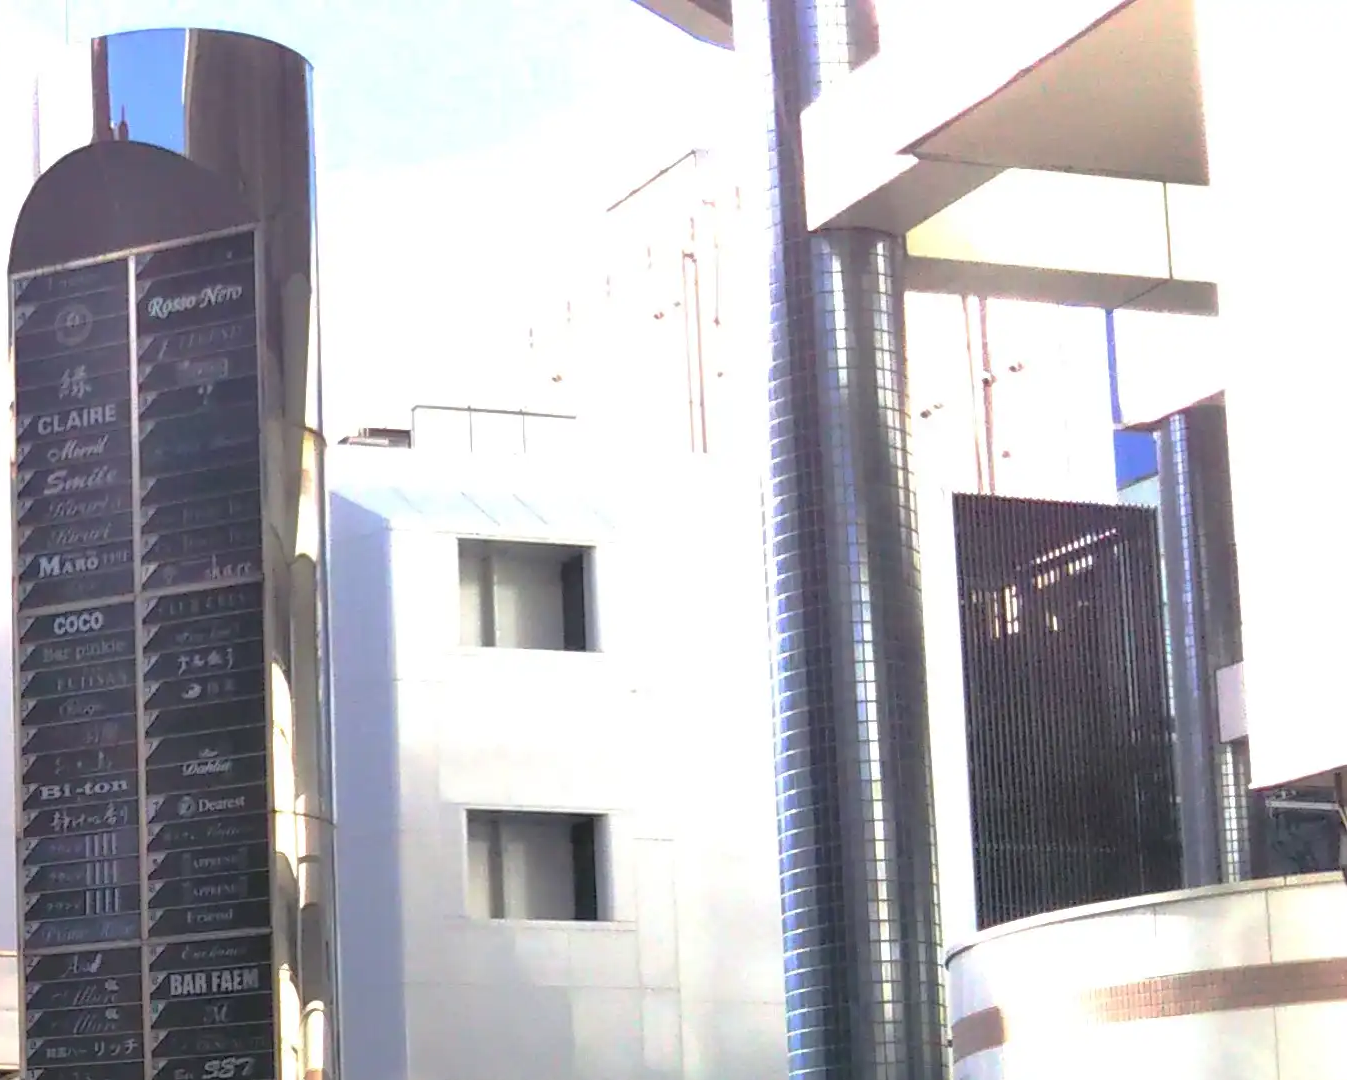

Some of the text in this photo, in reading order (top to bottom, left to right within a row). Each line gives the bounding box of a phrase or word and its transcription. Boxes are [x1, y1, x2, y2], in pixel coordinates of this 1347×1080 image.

[38, 404, 116, 435] CLAIRE
[54, 612, 103, 635] COCO
[40, 782, 129, 801] Bi-ton
[198, 795, 246, 813] Dearest
[170, 971, 207, 996] BAR
[94, 1037, 138, 1057] リッチ
